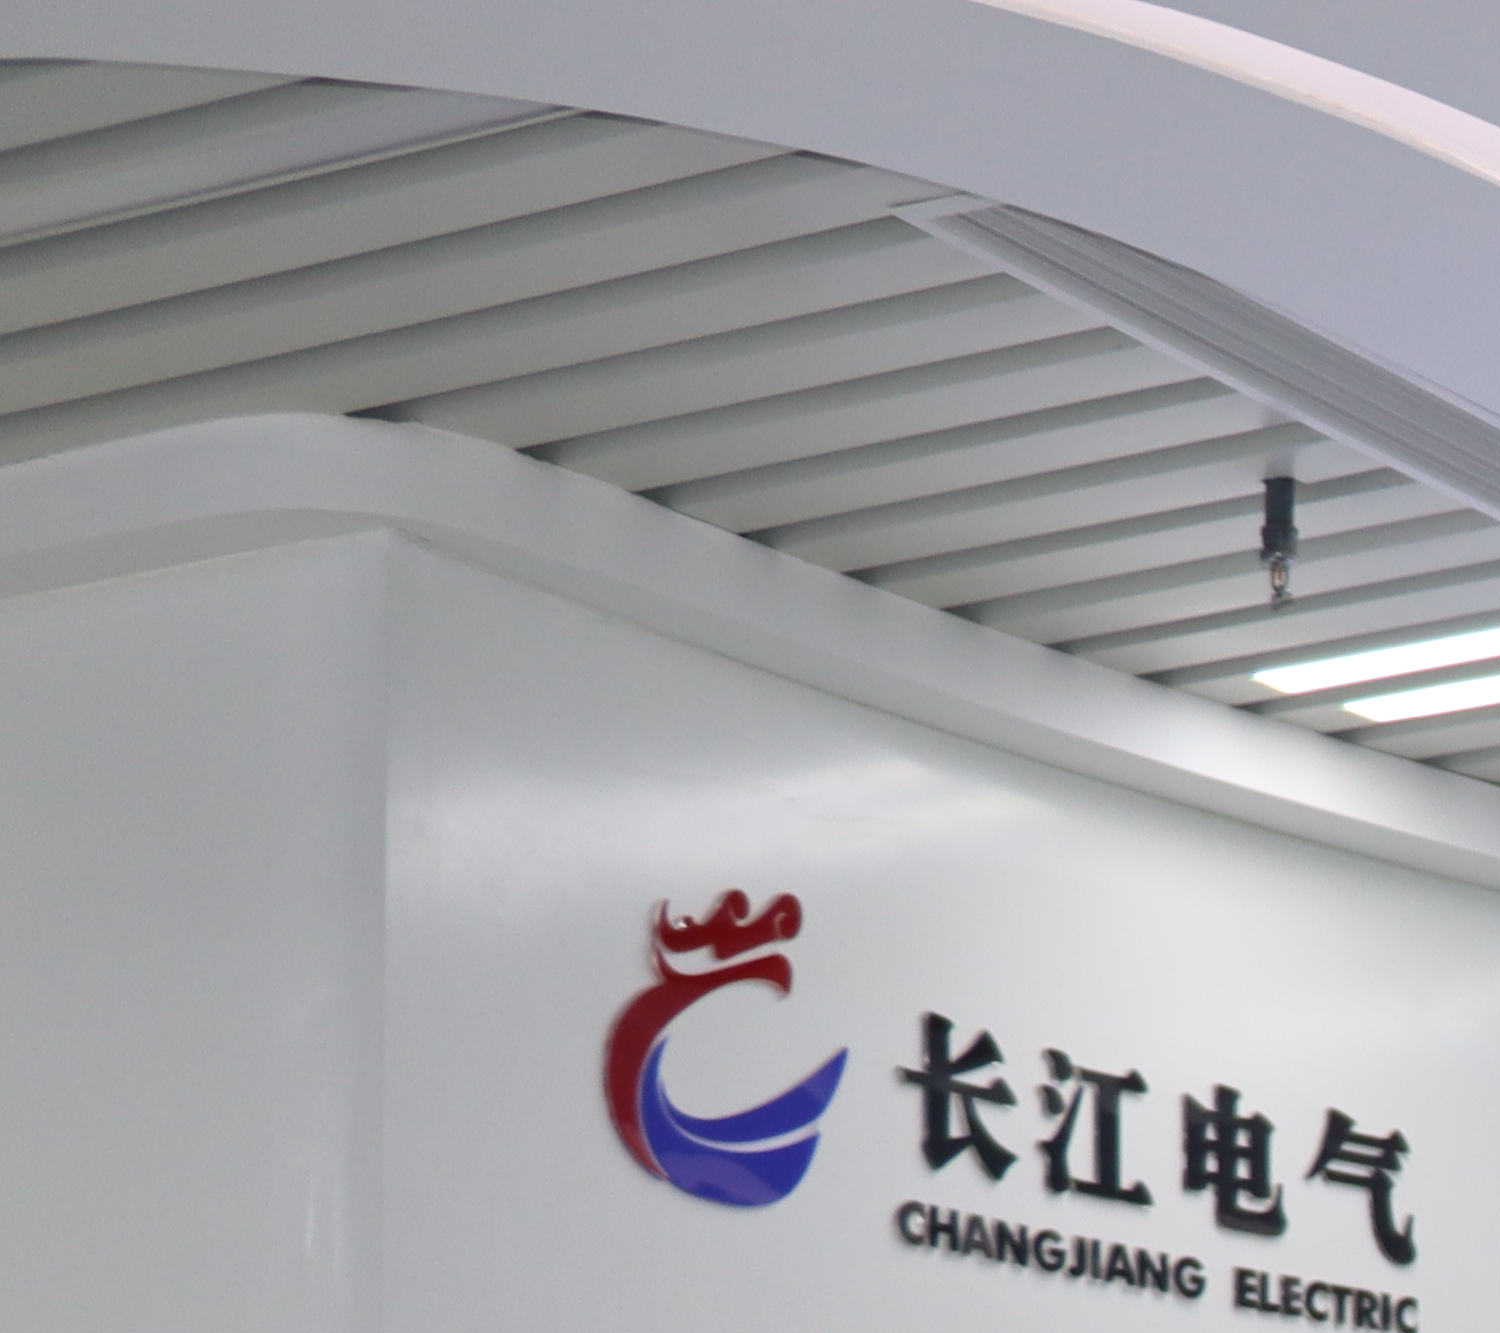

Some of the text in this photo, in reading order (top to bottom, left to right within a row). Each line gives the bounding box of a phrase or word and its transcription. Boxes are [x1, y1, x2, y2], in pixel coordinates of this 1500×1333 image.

[895, 1010, 1417, 1266] 长江电气
[895, 1200, 1205, 1299] CHANGJIANG
